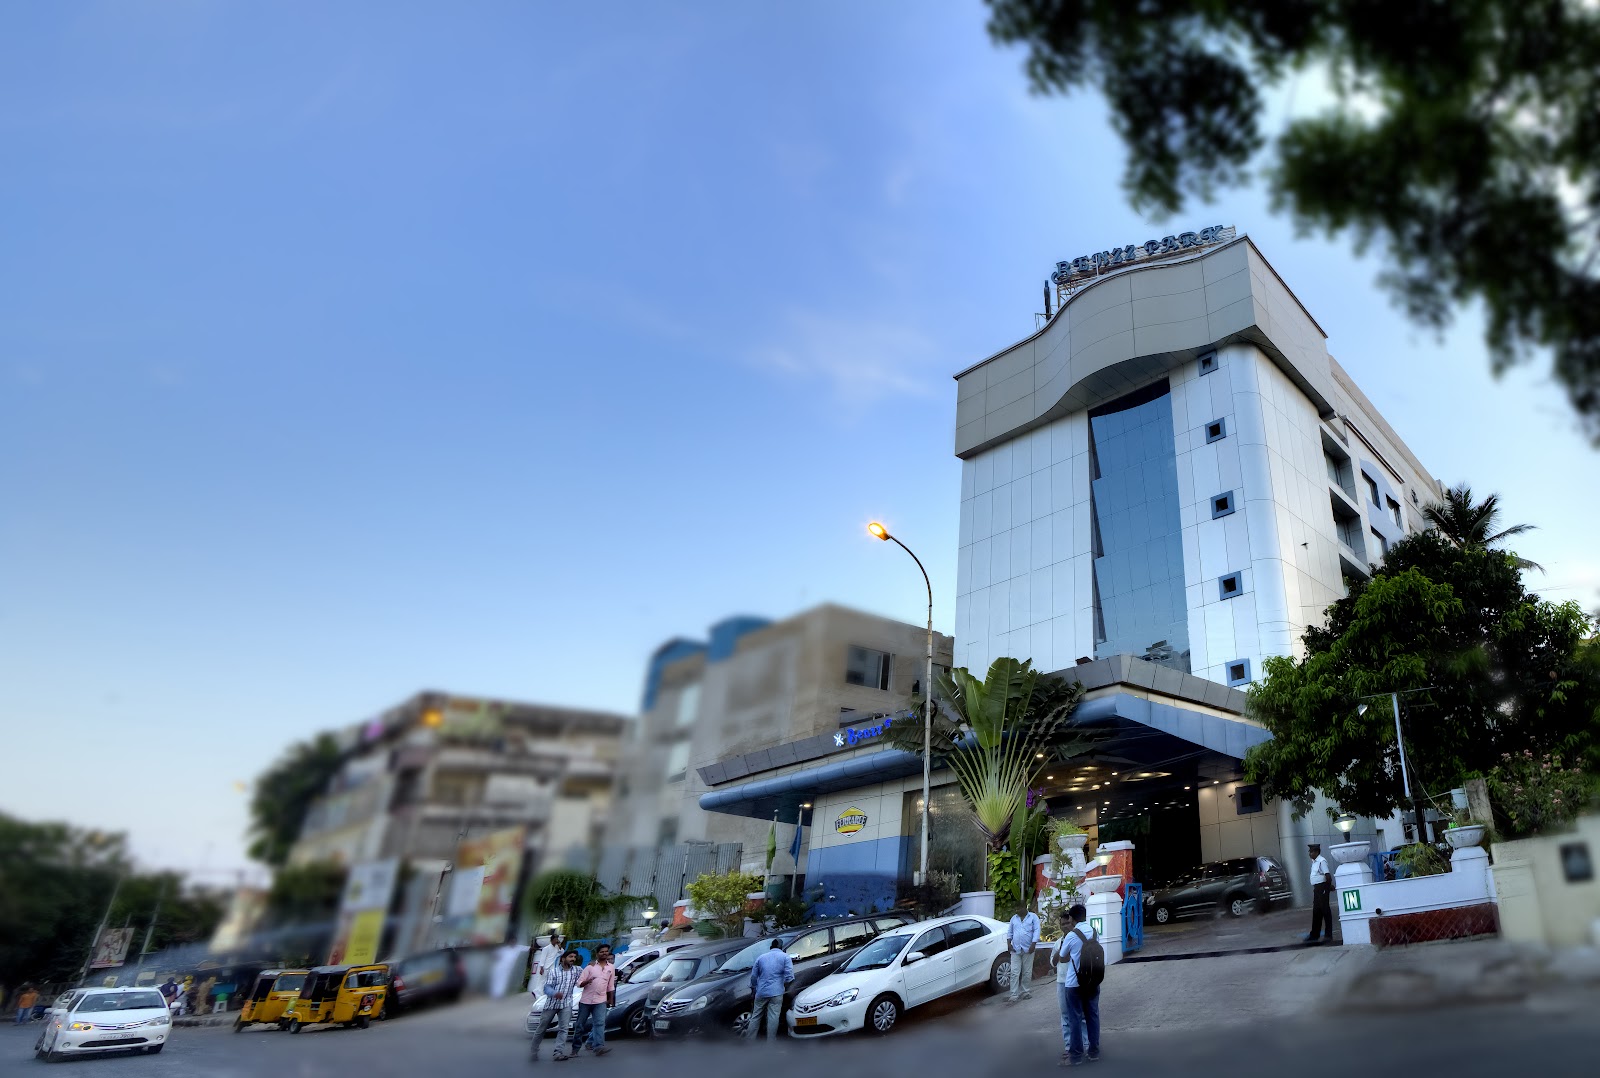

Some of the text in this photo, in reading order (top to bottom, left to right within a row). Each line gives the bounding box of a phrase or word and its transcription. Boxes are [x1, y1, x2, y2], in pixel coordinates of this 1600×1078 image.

[1051, 225, 1223, 284] BENZZ PARK
[1345, 891, 1358, 909] IN
[1092, 919, 1102, 933] IN
